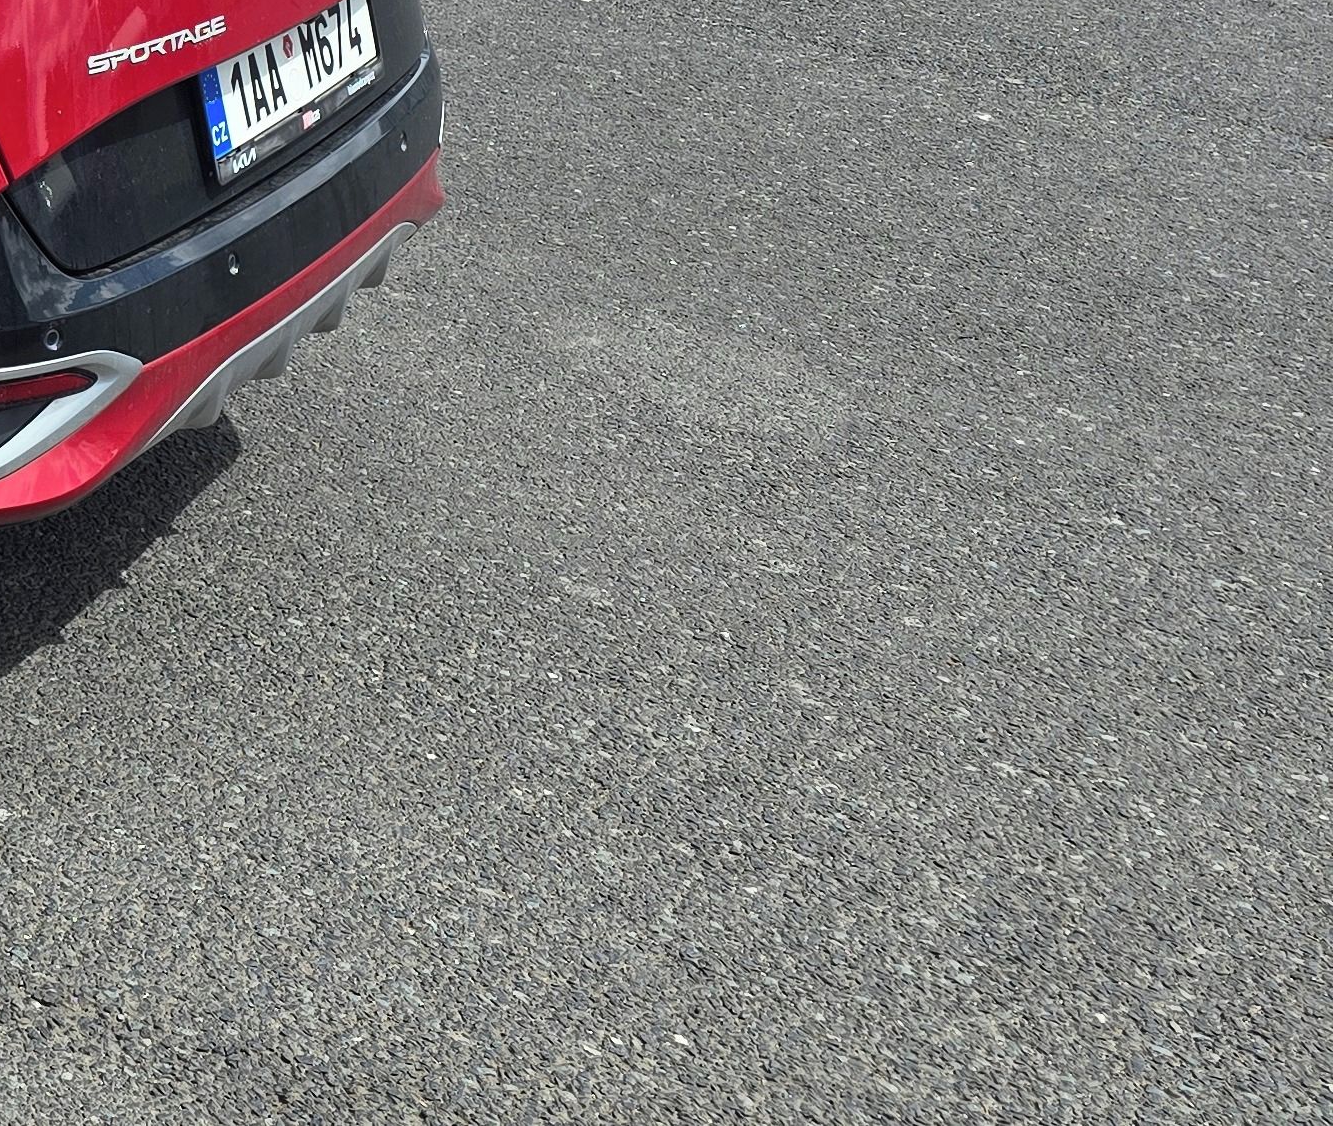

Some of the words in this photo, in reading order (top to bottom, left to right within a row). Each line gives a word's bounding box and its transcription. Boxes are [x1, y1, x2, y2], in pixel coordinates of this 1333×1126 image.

[87, 14, 227, 75] SPORTAGE
[230, 42, 288, 129] 1AA
[211, 120, 229, 147] CZ
